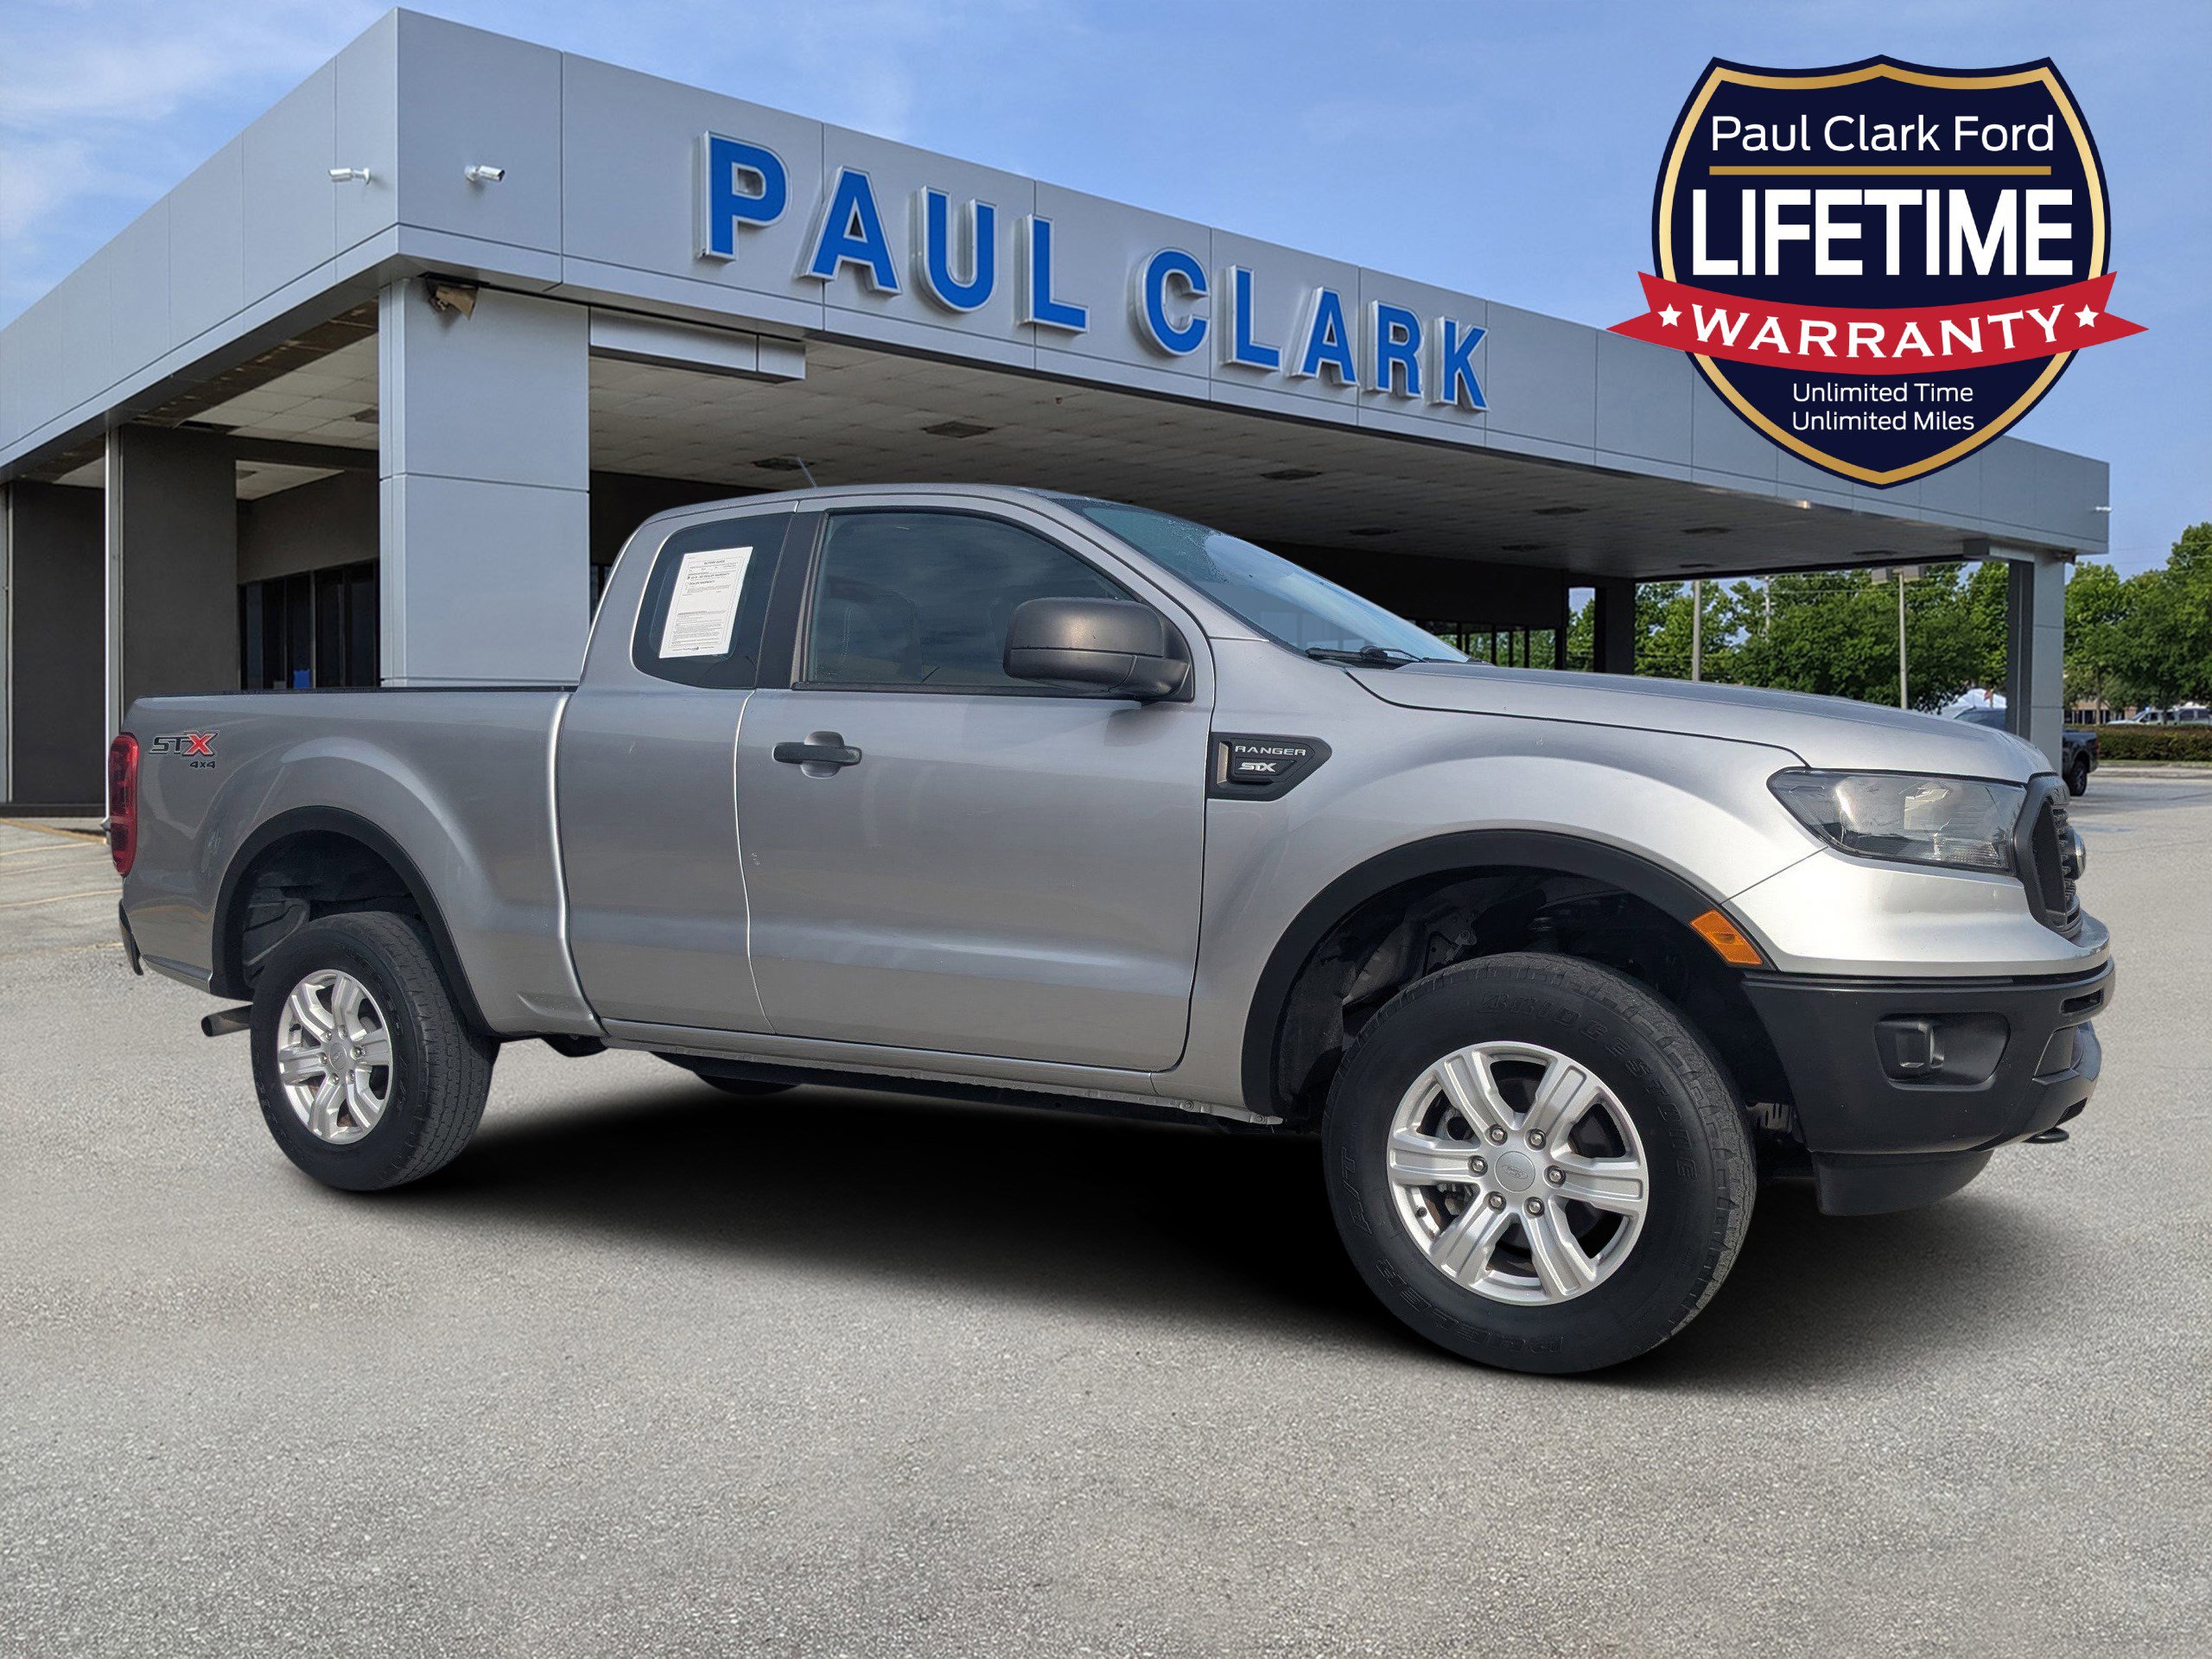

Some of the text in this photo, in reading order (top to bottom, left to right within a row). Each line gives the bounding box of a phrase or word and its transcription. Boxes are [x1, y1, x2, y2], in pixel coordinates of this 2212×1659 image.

[702, 131, 1490, 412] PAUL CLARK
[149, 730, 219, 757] STX
[1234, 745, 1306, 757] RANGER
[1237, 761, 1277, 772] STX
